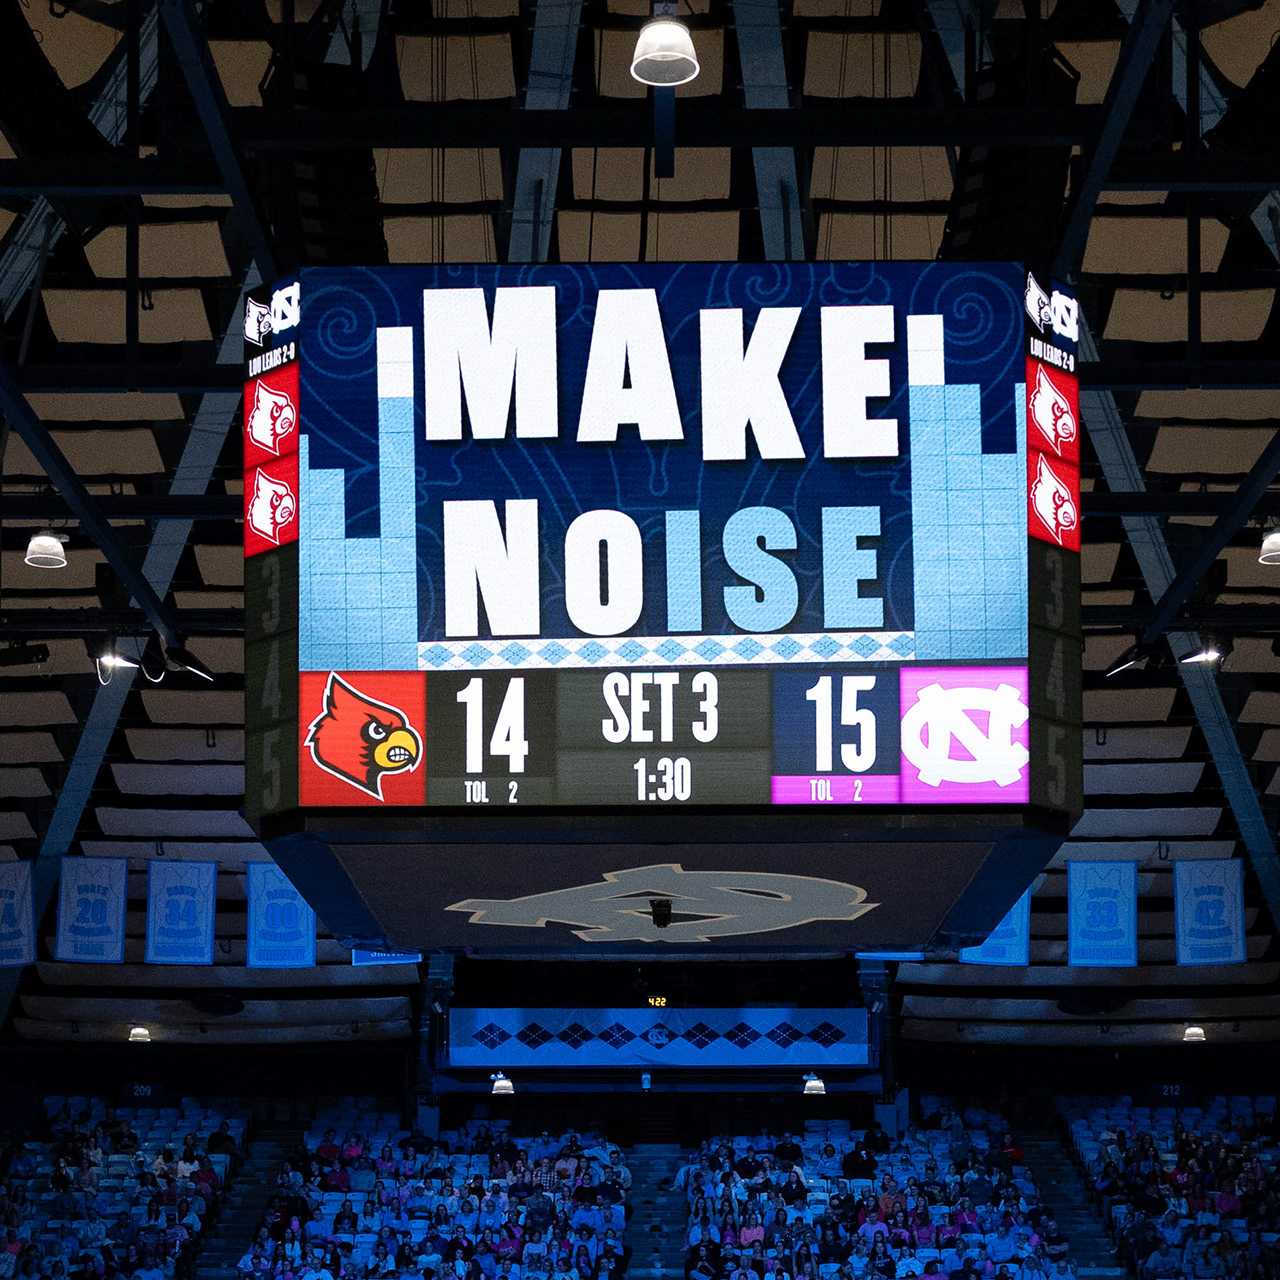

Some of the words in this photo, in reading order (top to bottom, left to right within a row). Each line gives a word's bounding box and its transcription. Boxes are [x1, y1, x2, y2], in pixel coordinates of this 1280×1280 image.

[249, 356, 262, 377] LOU
[262, 347, 281, 371] LEADS
[283, 342, 296, 363] 2-0
[1030, 337, 1043, 358] LOU
[1063, 352, 1075, 372] 2-0
[422, 285, 900, 461] MAKE
[443, 498, 884, 637] NOISE
[456, 677, 529, 773] 14
[601, 671, 680, 744] SET
[691, 671, 719, 743] 3
[805, 675, 877, 773] 15
[464, 781, 489, 803] TOL
[508, 781, 518, 803] 2
[633, 757, 691, 801] 1:30
[809, 779, 833, 802] TOL
[853, 779, 863, 802] 2
[77, 898, 107, 924] 20
[165, 899, 196, 924] 34
[266, 902, 298, 928] 00
[1086, 901, 1119, 928] 33
